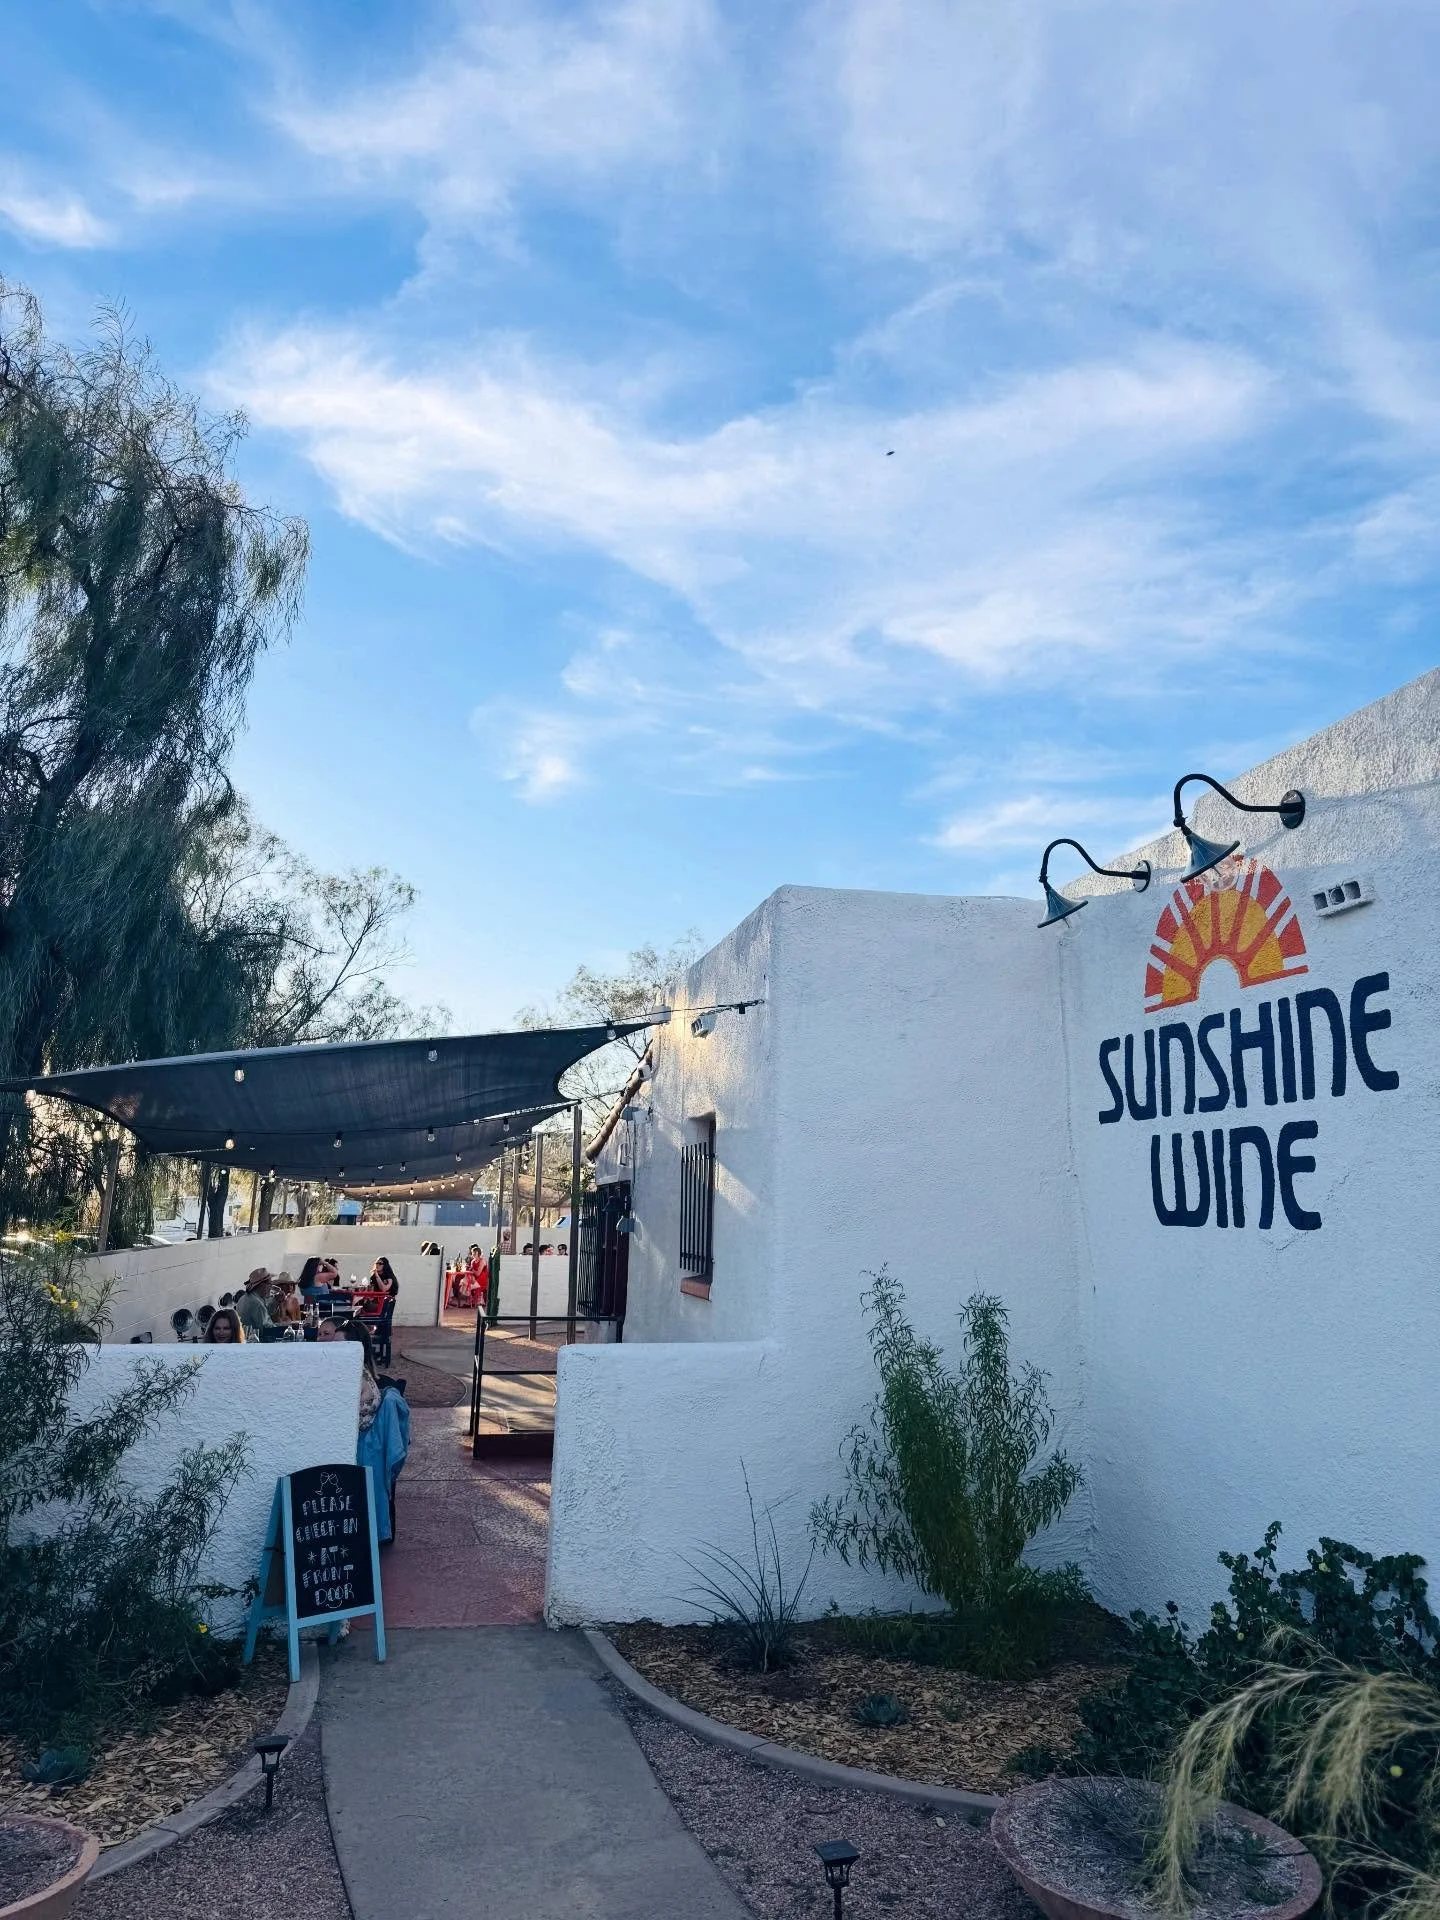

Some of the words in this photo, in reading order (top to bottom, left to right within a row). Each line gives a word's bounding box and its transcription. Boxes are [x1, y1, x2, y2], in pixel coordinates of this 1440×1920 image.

[1099, 972, 1400, 1124] SUNSHINE
[1151, 1120, 1322, 1230] WINE
[302, 1495, 354, 1516] PLEASE
[302, 1565, 354, 1588] FRONT
[314, 1584, 355, 1606] DOOR
